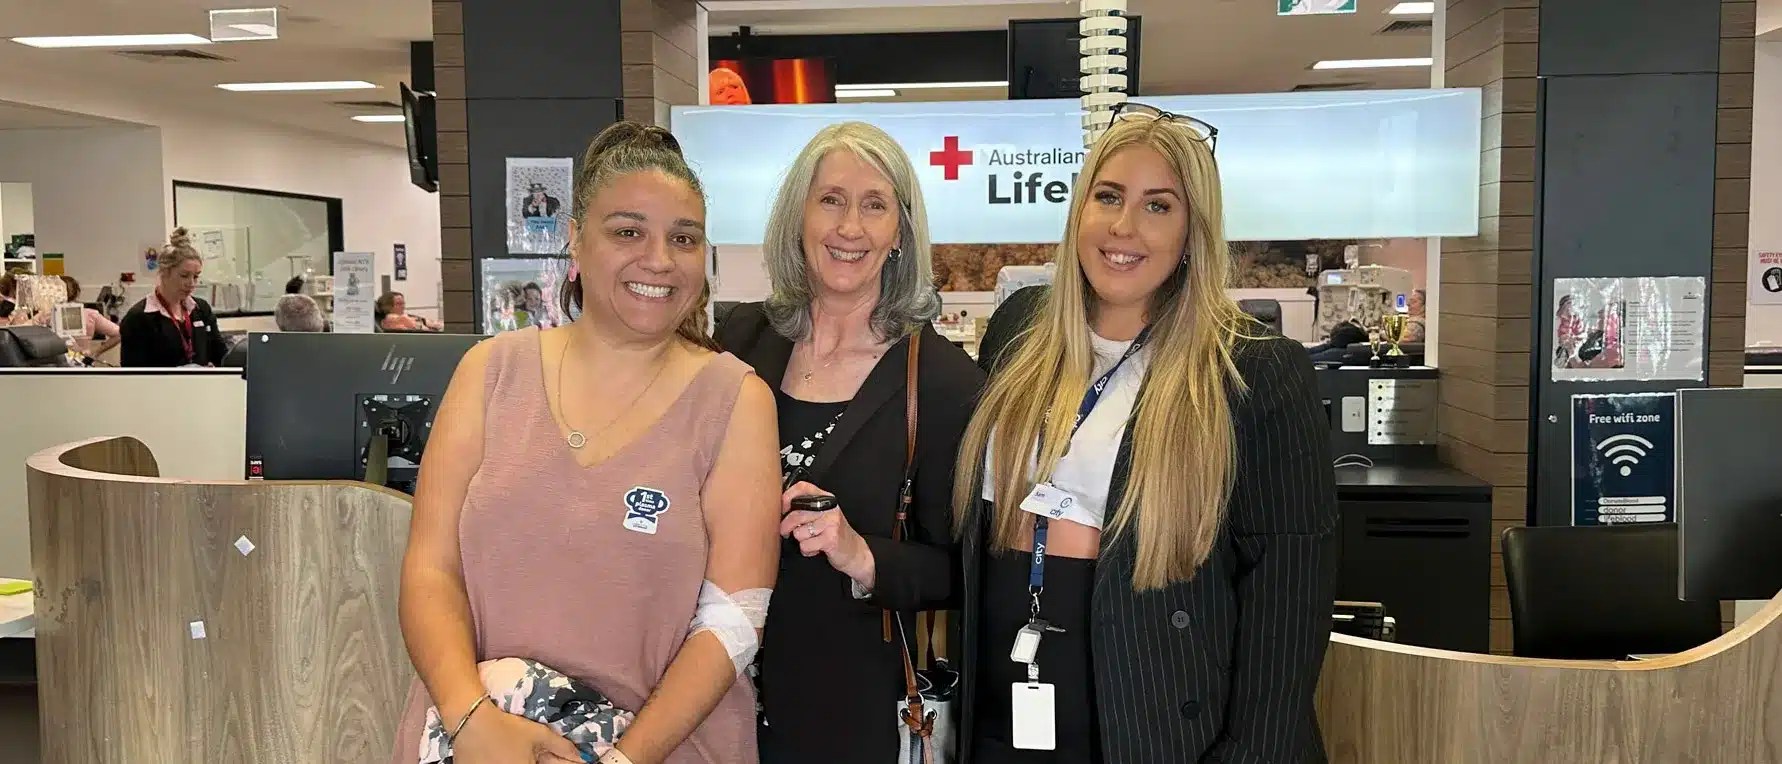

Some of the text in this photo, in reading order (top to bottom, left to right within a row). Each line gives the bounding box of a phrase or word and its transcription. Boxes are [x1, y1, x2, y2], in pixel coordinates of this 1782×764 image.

[989, 148, 1085, 166] Australian
[988, 171, 1079, 204] Life
[1589, 413, 1660, 424] Free wifi zone
[640, 491, 654, 502] 1st
[634, 502, 656, 510] plasma
[1035, 542, 1046, 565] city
